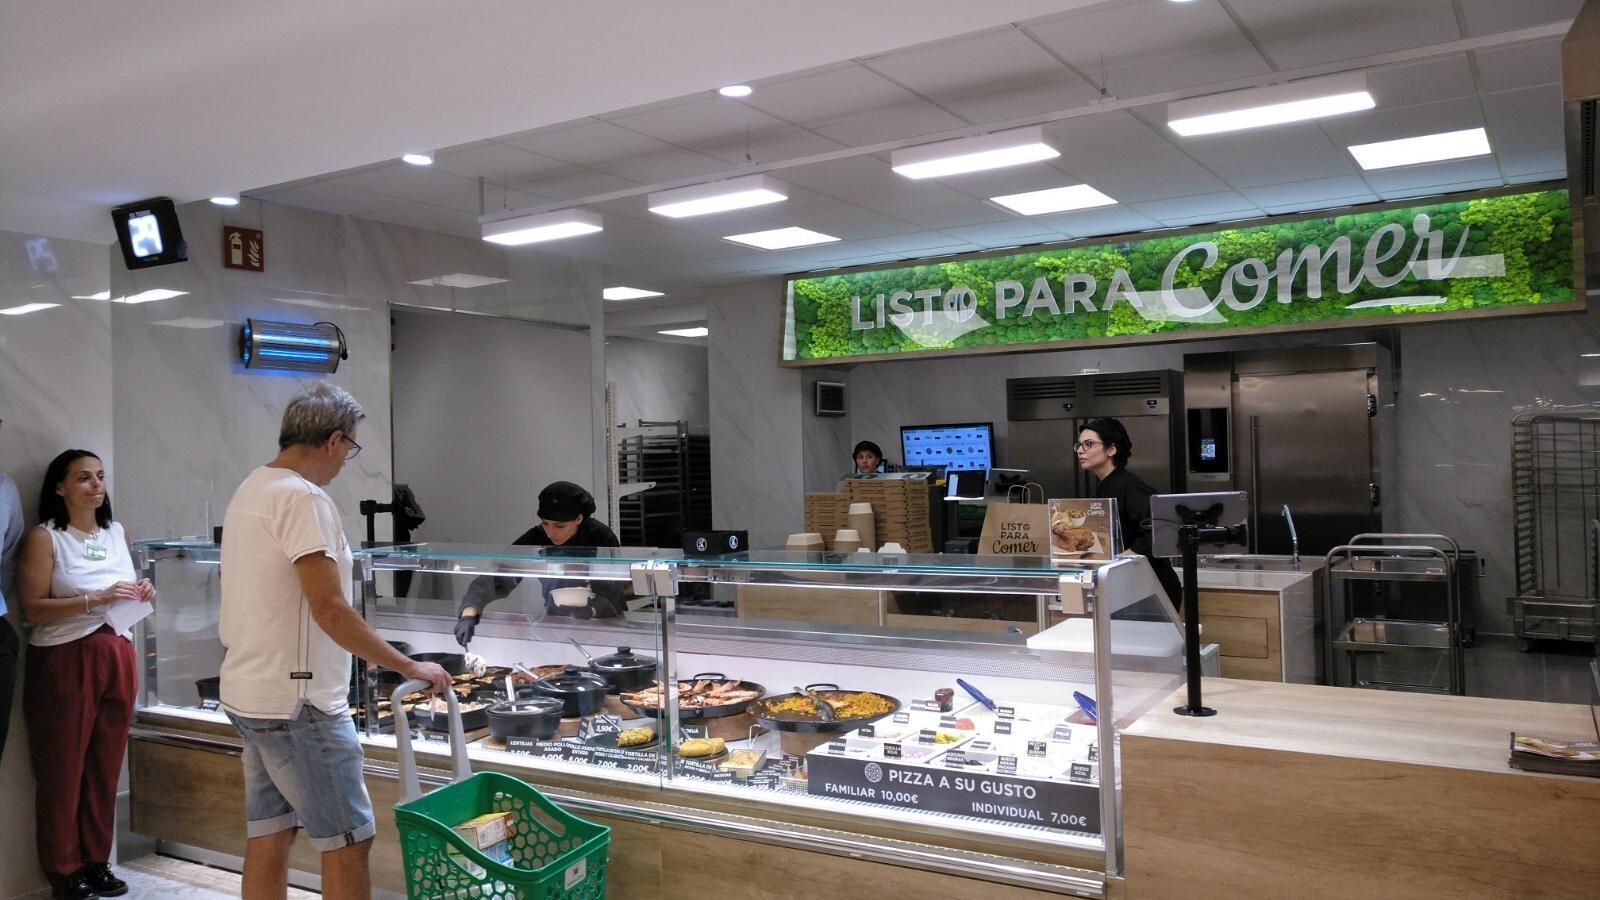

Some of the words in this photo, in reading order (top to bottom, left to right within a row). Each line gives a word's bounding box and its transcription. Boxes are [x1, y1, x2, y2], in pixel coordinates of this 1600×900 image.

[850, 285, 976, 332] LISTO
[996, 266, 1146, 320] PARA
[1160, 213, 1470, 318] Comer
[1001, 522, 1030, 531] LISTO
[1000, 531, 1029, 540] PARA
[992, 538, 1039, 554] Comer
[625, 750, 648, 758] TORTILLA
[685, 760, 706, 768] TORTILLA
[889, 768, 934, 788] PIZZA
[938, 775, 951, 789] A
[954, 777, 976, 792] SU
[980, 780, 1037, 800] GUSTO
[824, 782, 876, 799] FAMILIAR
[881, 789, 919, 804] 10,00€
[971, 801, 1044, 822] INDIVIDUAL
[1050, 811, 1088, 828] 7,00€
